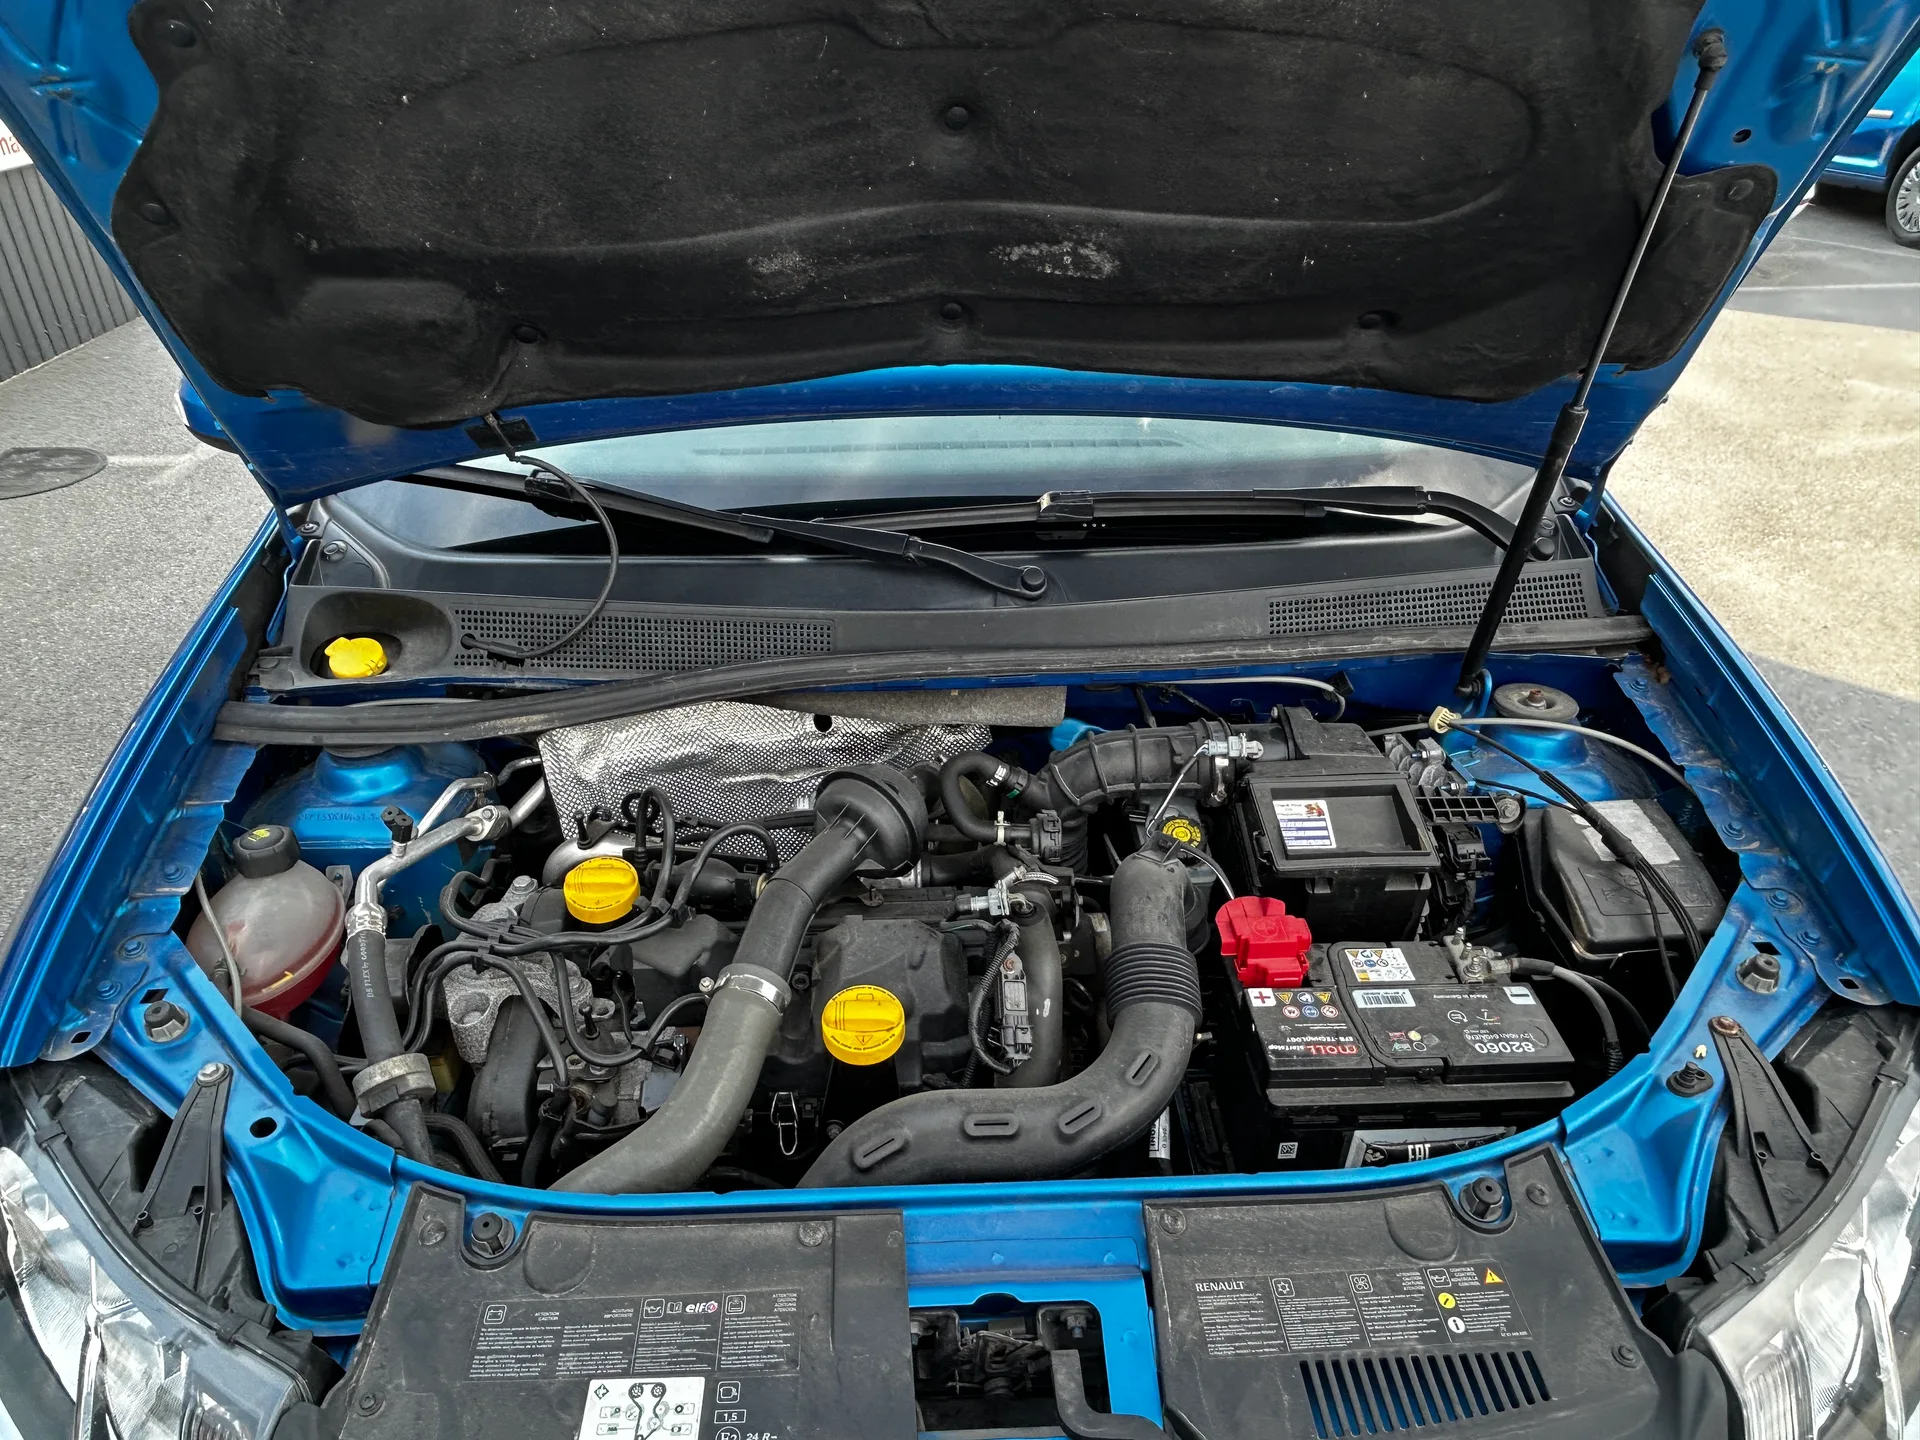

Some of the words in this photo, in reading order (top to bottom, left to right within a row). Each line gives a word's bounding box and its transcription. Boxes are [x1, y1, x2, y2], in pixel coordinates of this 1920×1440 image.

[1474, 1041, 1536, 1053] 82060
[1195, 1280, 1246, 1292] RENAULT
[685, 1302, 707, 1313] elf
[723, 1412, 738, 1423] 1,5
